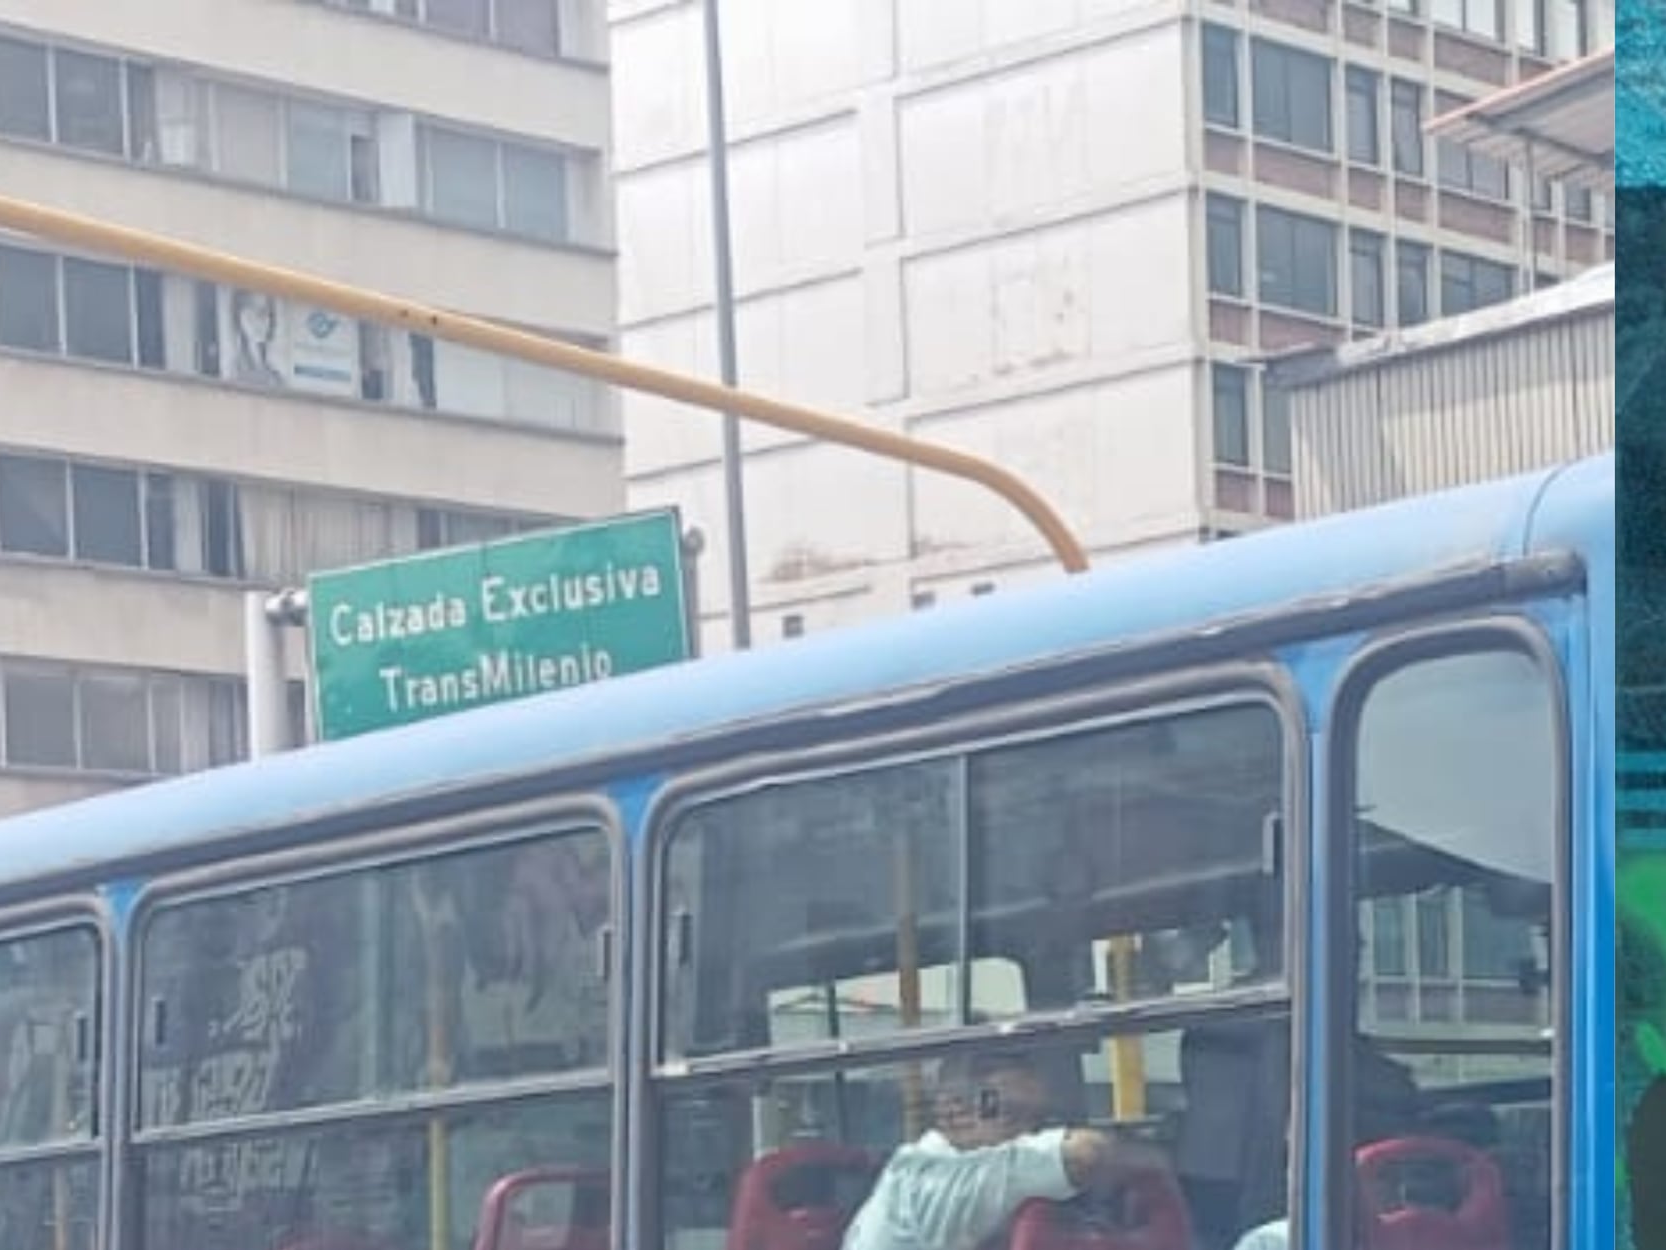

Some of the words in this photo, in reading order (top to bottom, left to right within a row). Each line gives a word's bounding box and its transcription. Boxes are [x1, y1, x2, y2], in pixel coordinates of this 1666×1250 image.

[331, 590, 467, 646] Calzada
[481, 561, 661, 622] Exclusiva
[379, 646, 614, 712] TransMilenio
